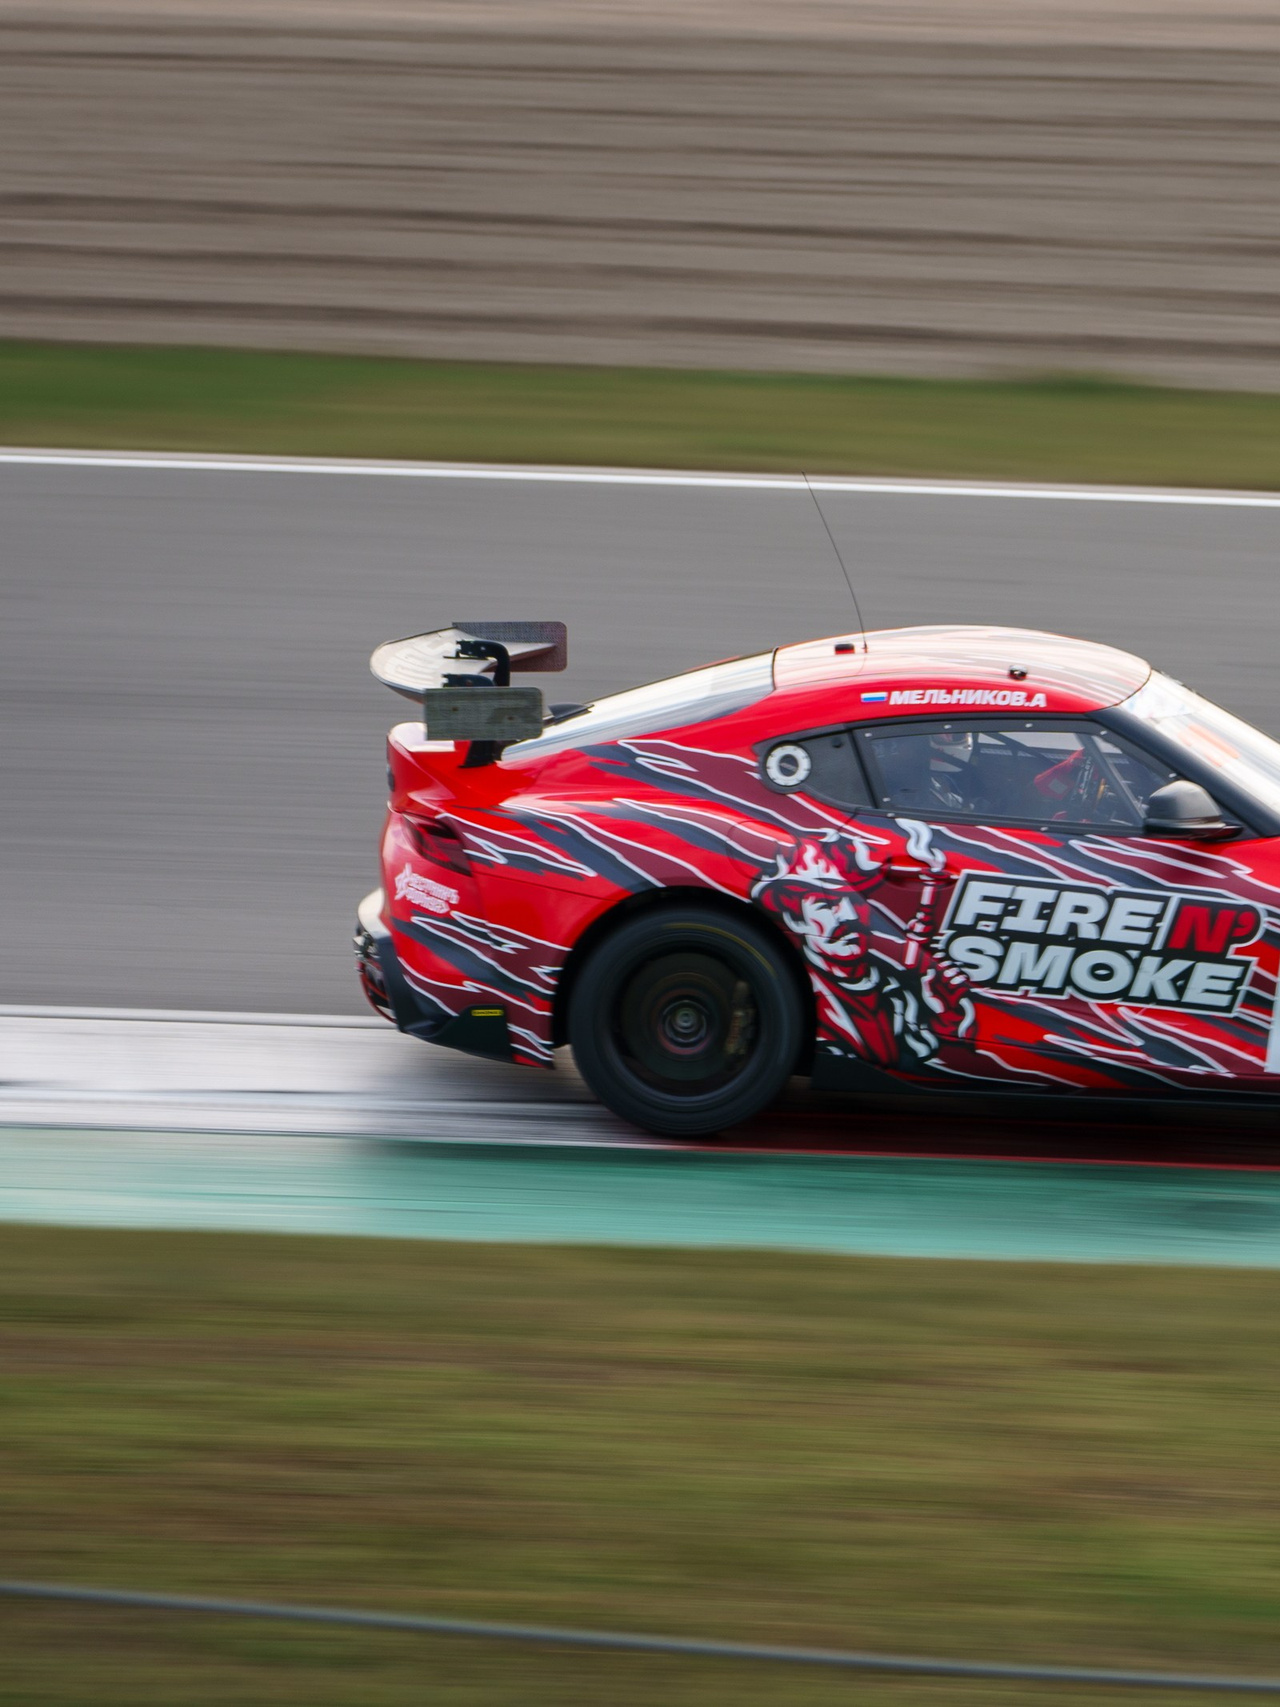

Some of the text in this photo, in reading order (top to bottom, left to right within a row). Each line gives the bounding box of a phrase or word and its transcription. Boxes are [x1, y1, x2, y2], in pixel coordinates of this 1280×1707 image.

[888, 689, 1047, 708] МЕЛЬНИКОВ.А
[953, 880, 1165, 946] FIRE
[948, 935, 1246, 1008] SMOKE
